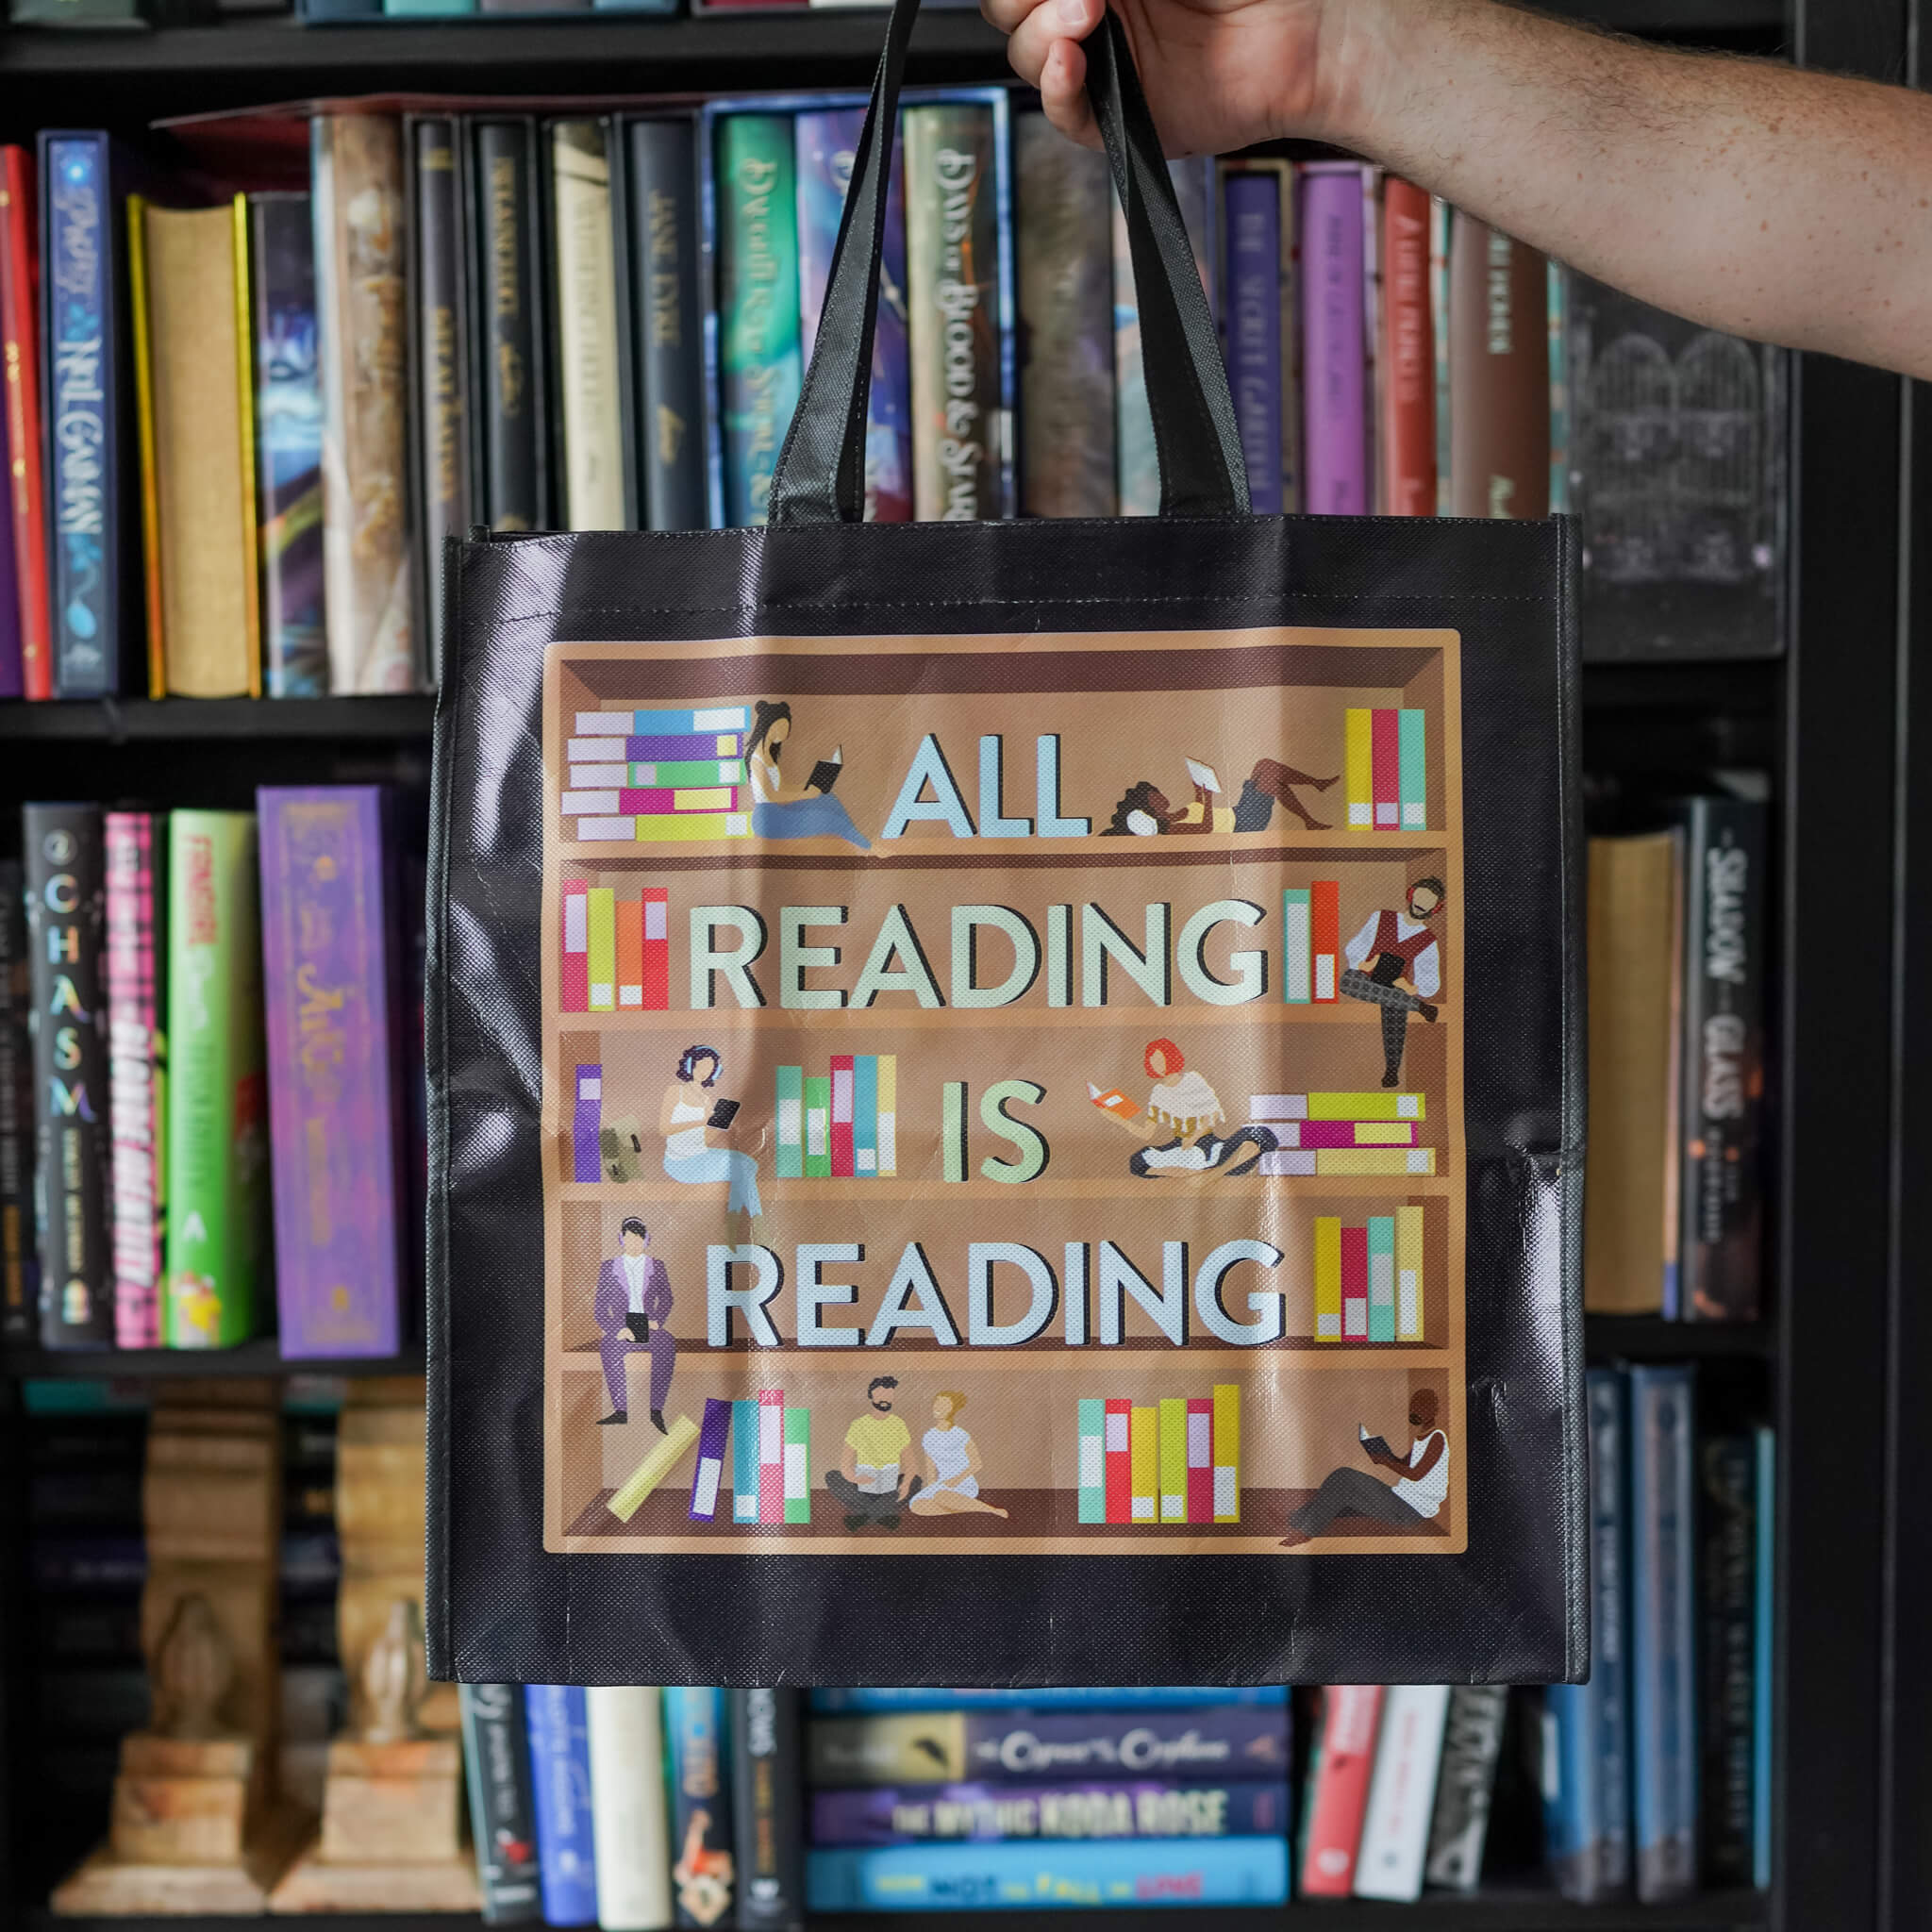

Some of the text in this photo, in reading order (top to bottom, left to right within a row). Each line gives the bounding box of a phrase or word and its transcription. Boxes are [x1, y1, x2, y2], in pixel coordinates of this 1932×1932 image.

[934, 279, 980, 396] BLOOD
[57, 409, 104, 536] GAIMAN
[880, 731, 1093, 841] ALL
[689, 898, 1269, 1011] READING
[1706, 847, 1748, 984] SHADOW
[1703, 1013, 1747, 1120] GLASS
[943, 1078, 1051, 1185] IS
[707, 1239, 1286, 1349] READING
[1136, 1788, 1228, 1836] ROSE
